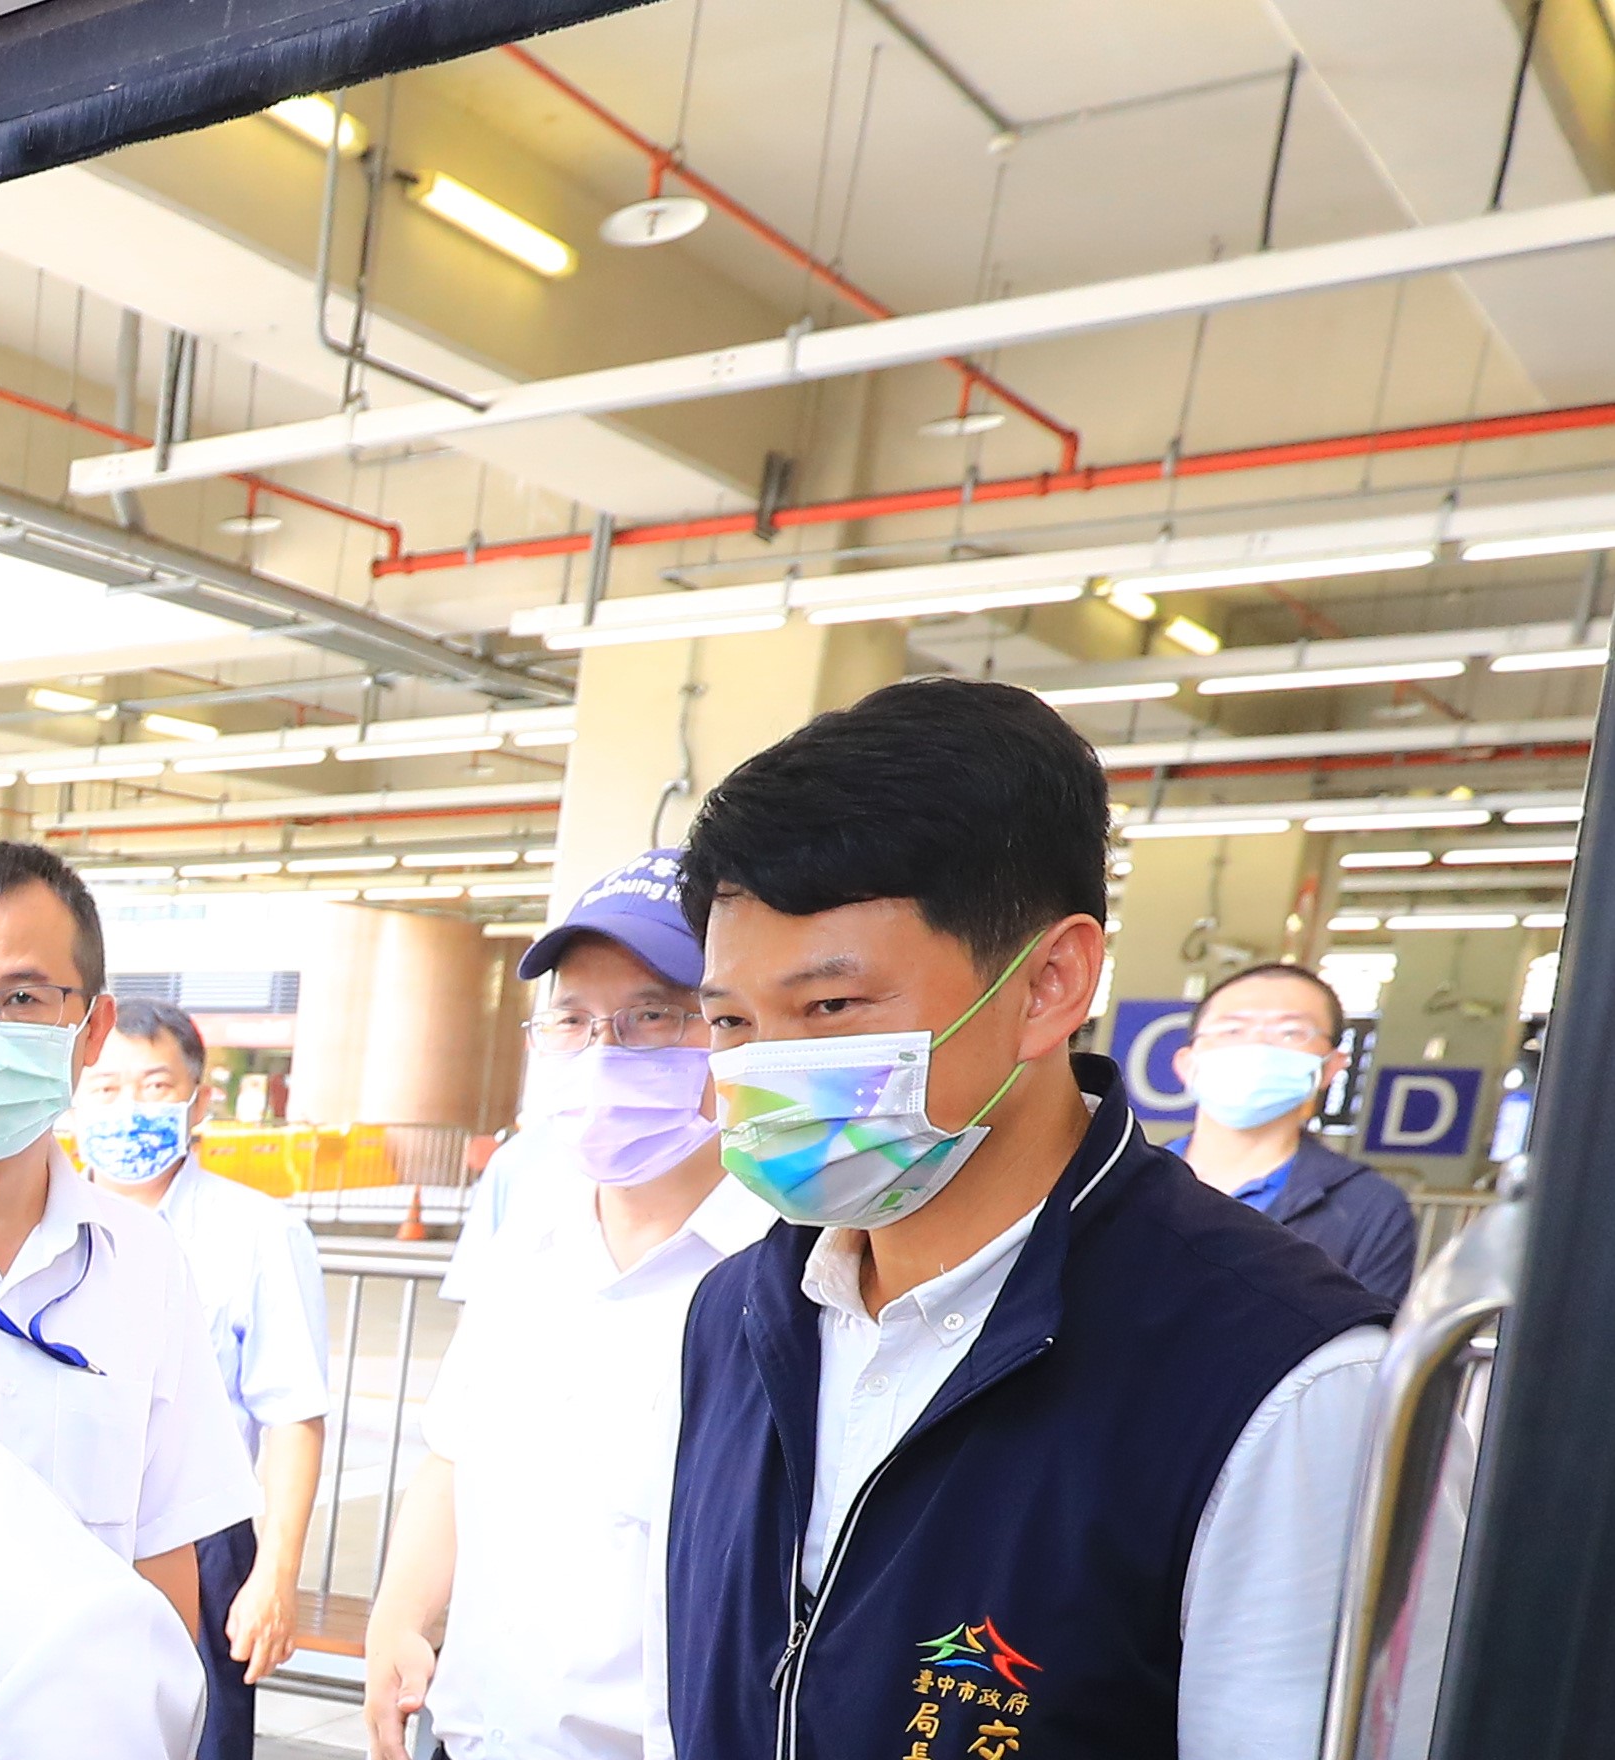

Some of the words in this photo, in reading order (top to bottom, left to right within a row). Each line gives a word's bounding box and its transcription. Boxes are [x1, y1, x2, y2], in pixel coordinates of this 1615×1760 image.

[1380, 1074, 1459, 1146] D
[912, 1669, 1030, 1717] 臺中市政府
